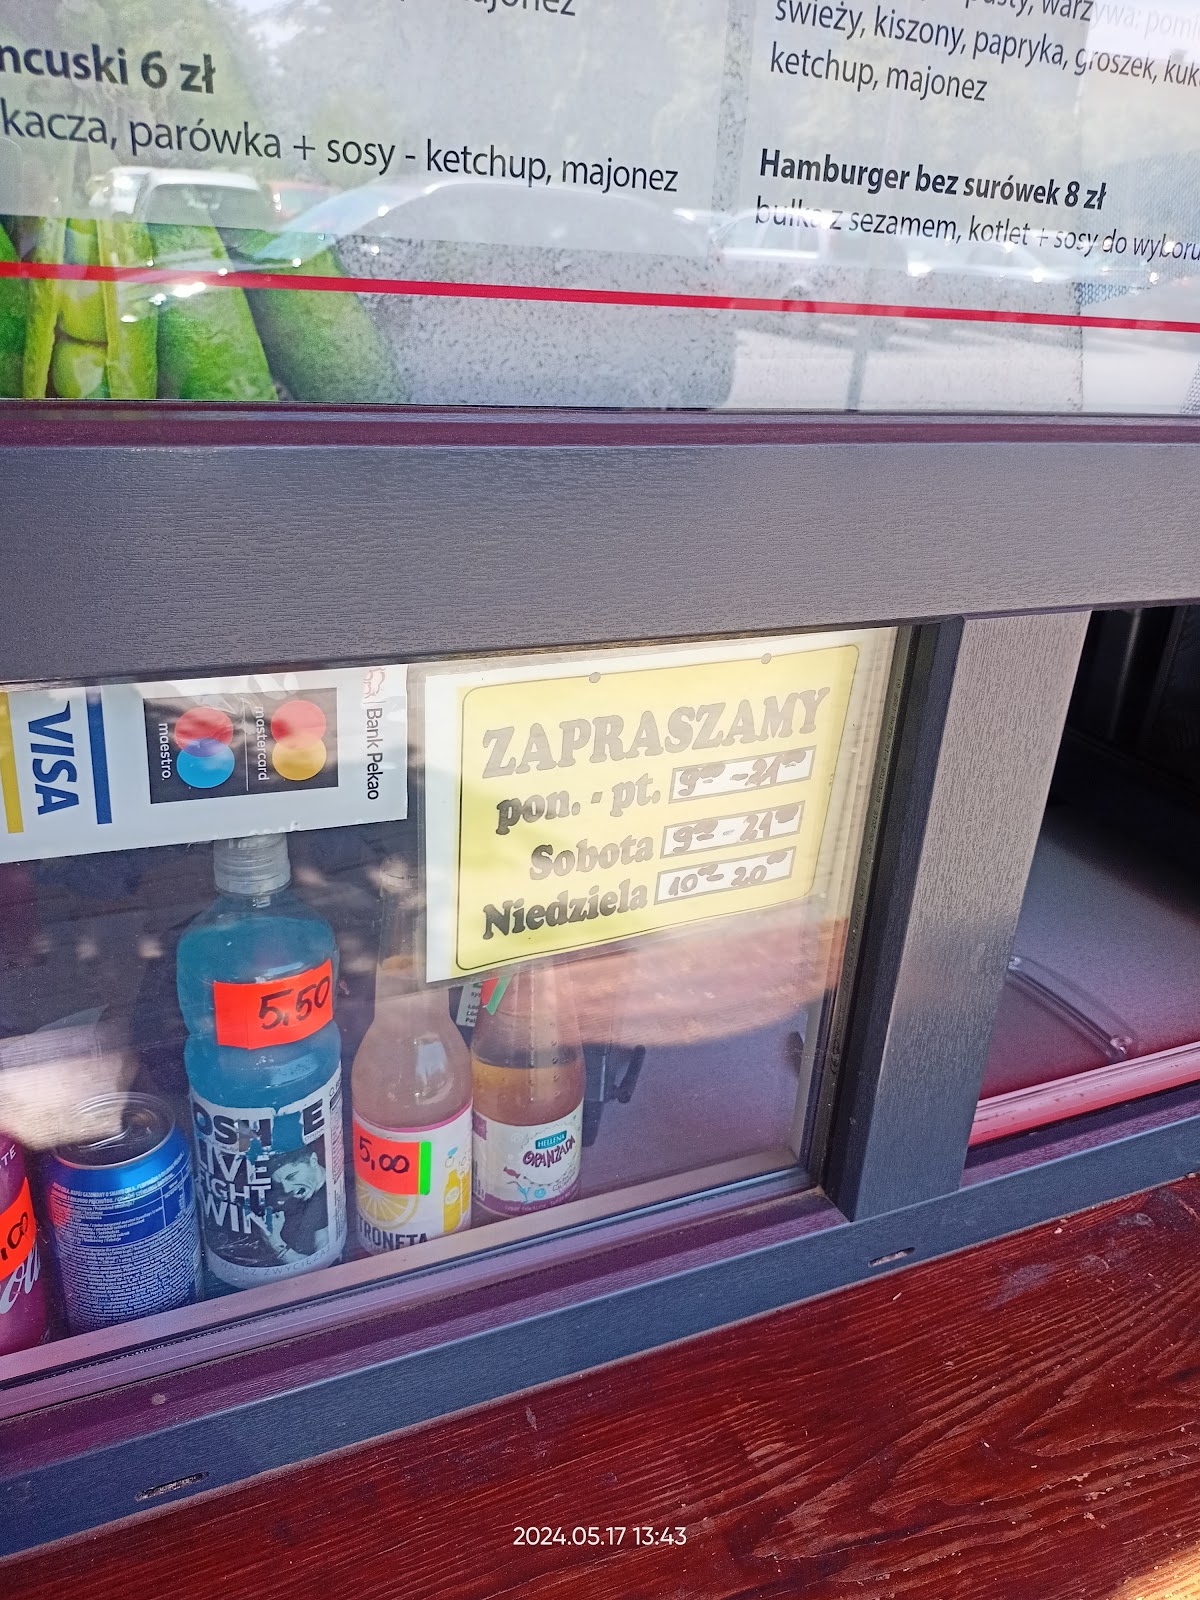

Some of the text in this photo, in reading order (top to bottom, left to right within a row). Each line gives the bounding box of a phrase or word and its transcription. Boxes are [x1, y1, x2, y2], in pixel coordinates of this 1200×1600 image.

[141, 50, 168, 89] 6
[180, 53, 216, 94] zł
[770, 41, 988, 102] ketchup, majonez
[874, 5, 967, 56] kiszony,
[973, 29, 1068, 71] papryka,
[1074, 47, 1158, 84] groszek,
[1164, 53, 1200, 88] kuk
[129, 117, 282, 160] parówka
[292, 135, 317, 161] +
[327, 136, 396, 176] sosy
[426, 139, 552, 188] ketchup,
[562, 157, 679, 194] majonez
[760, 148, 1107, 210] Hamburger bez surówek 8 zł
[829, 209, 844, 230] z
[849, 211, 961, 244] sezamem,
[968, 215, 1031, 246] kotlet
[1033, 226, 1049, 247] +
[1053, 230, 1099, 258] sosy
[1102, 228, 1127, 255] do
[28, 700, 80, 815] VISA
[255, 705, 271, 781] mastercard
[365, 706, 381, 801] Bank Pekao
[482, 686, 831, 779] ZAPRASZAMY
[496, 788, 581, 835] pon.
[609, 774, 661, 818] pt.
[529, 835, 654, 881] Sobota
[482, 878, 649, 941] Niedziela
[258, 975, 331, 1030] 5,50
[358, 1136, 410, 1175] 5,00
